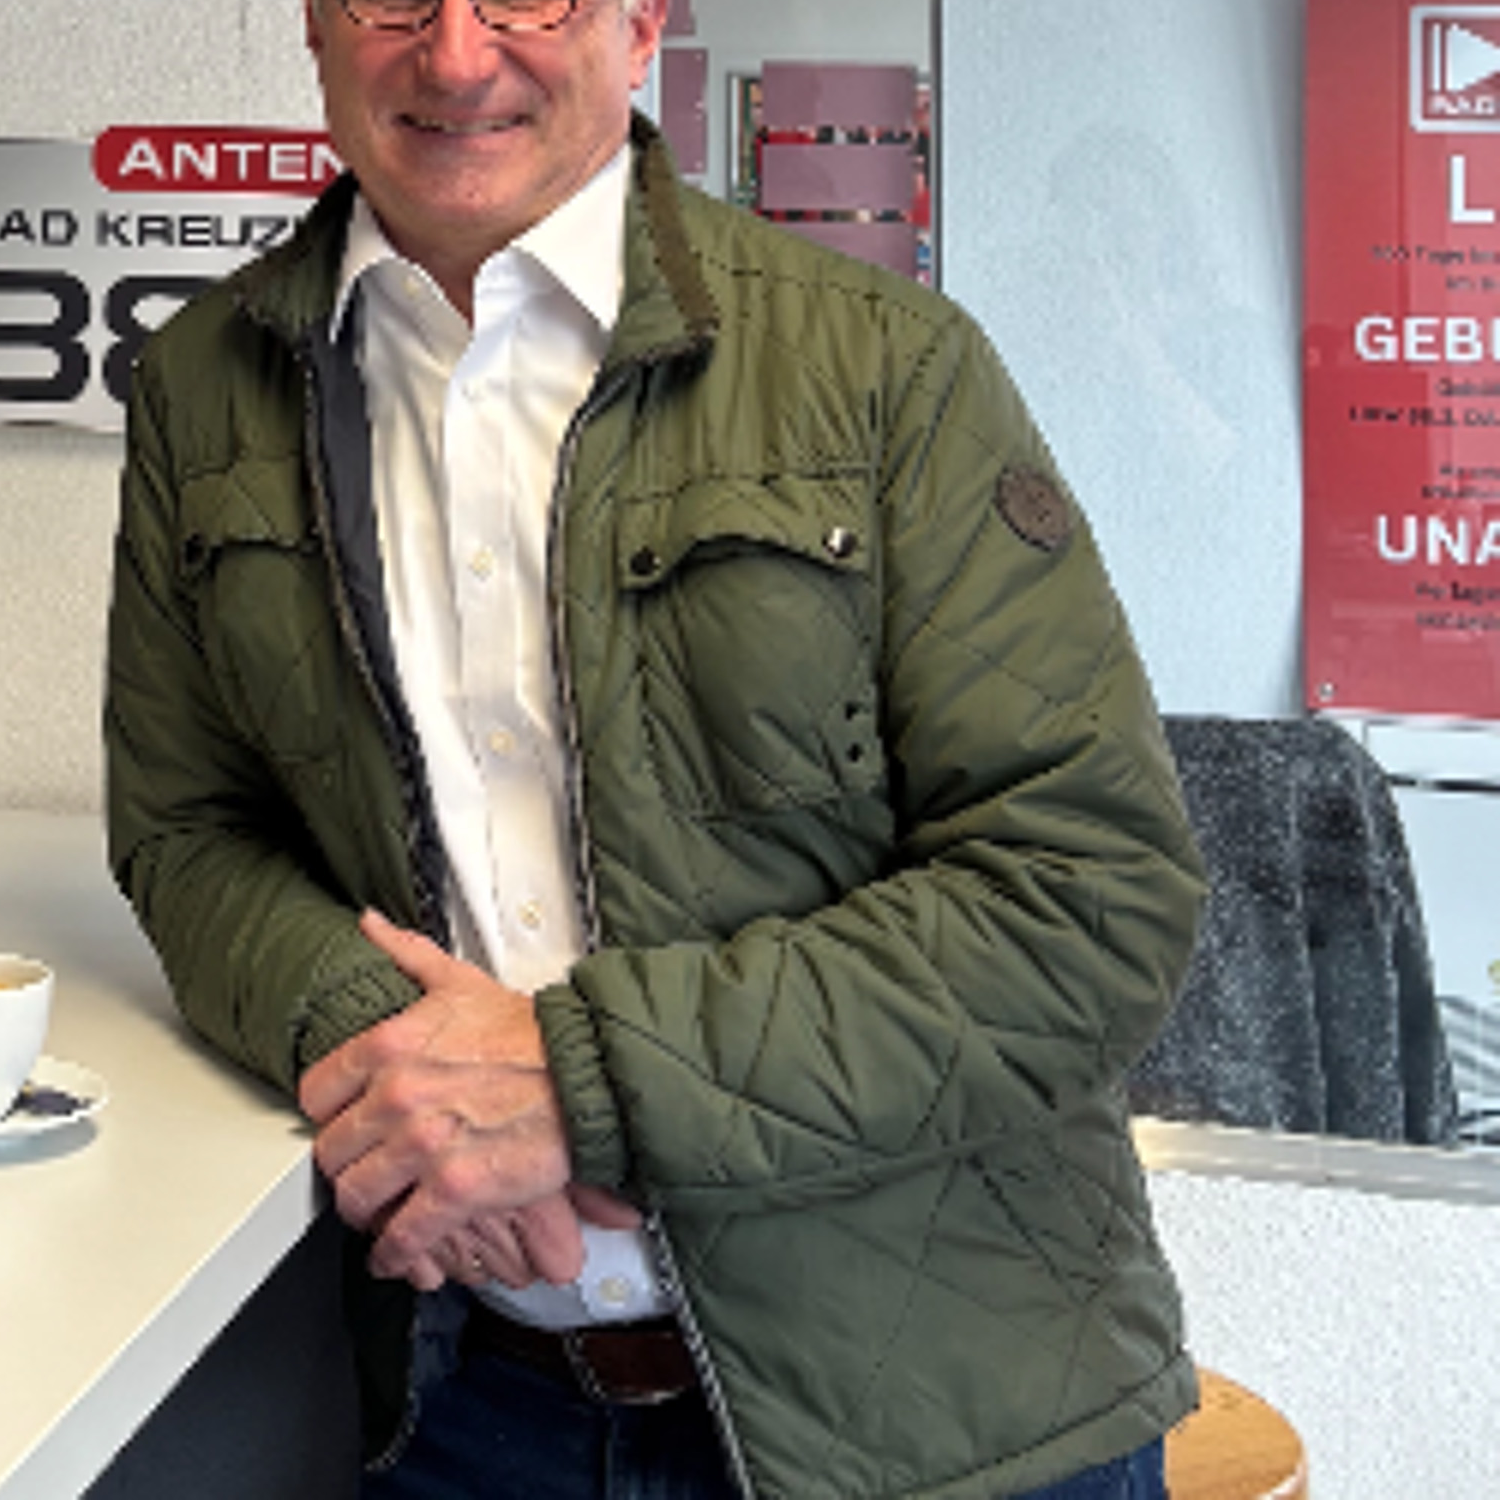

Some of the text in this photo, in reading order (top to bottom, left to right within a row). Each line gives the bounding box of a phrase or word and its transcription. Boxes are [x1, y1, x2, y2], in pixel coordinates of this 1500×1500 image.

[118, 138, 344, 182] ANTEN
[96, 213, 304, 250] KREUZ
[1355, 316, 1500, 362] GEB
